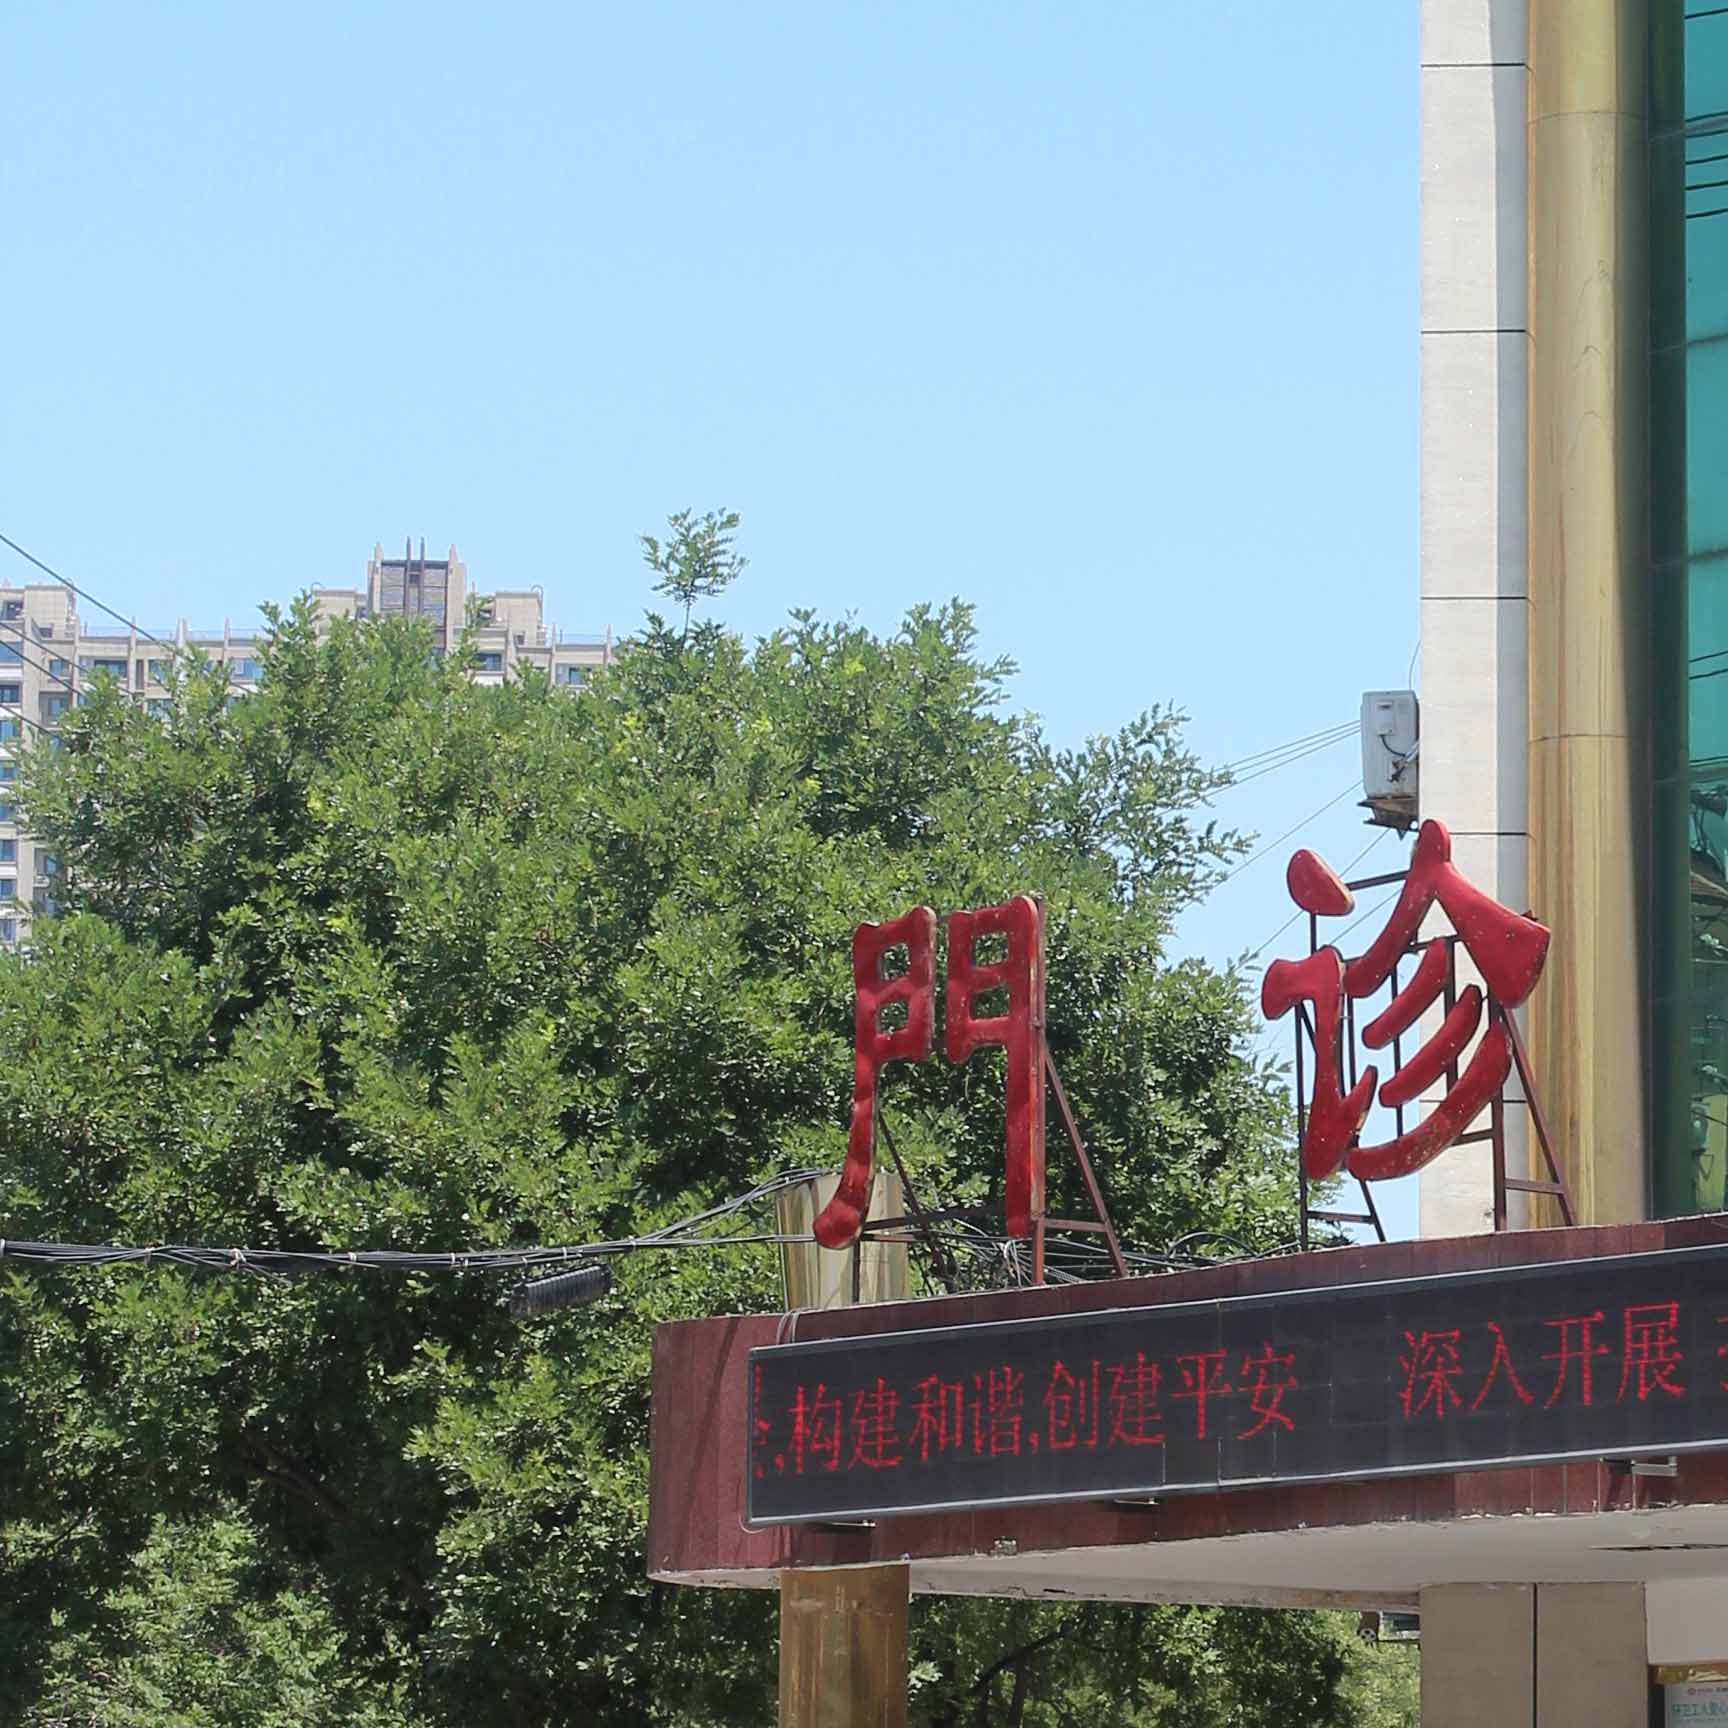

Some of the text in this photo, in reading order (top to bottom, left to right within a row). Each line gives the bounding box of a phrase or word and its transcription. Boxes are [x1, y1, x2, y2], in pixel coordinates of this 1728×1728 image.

[755, 1342, 1298, 1478] ,构建和谐,创建平安
[1399, 1298, 1687, 1420] 深入开展
